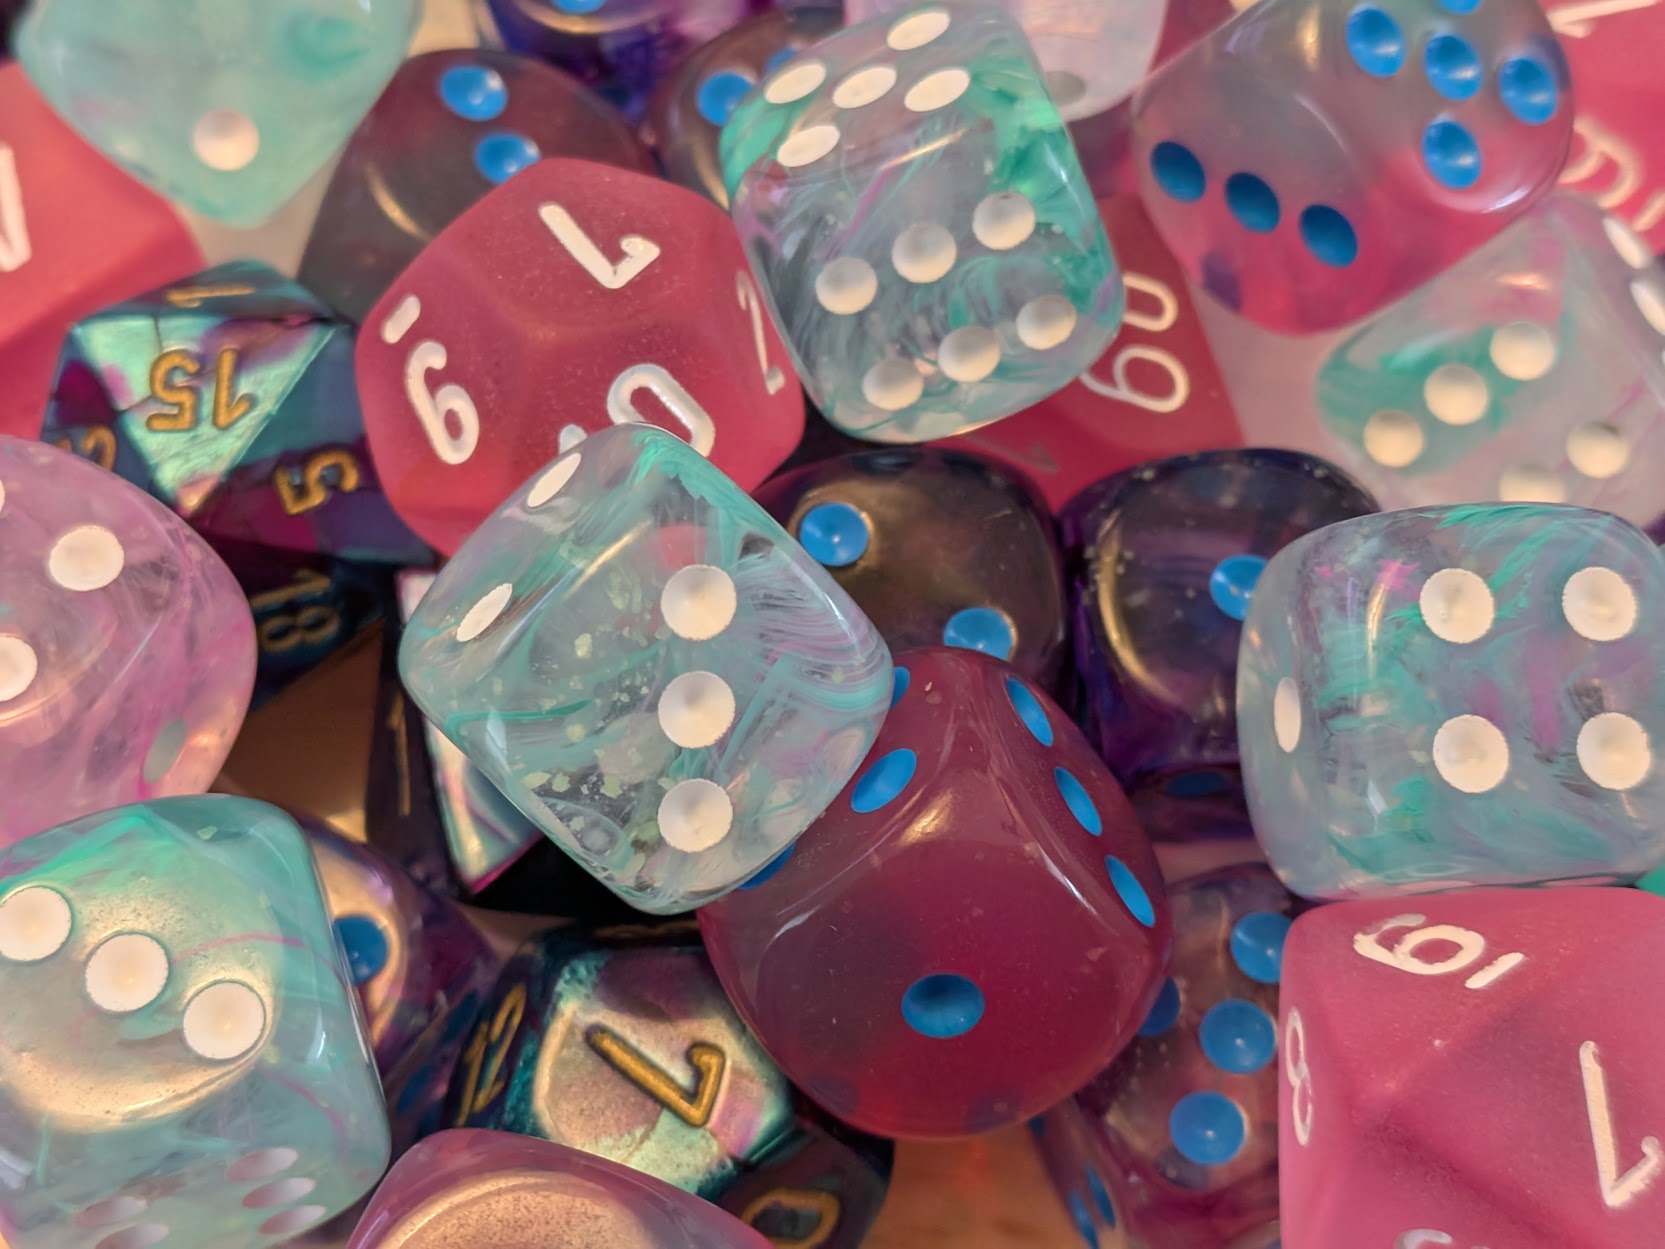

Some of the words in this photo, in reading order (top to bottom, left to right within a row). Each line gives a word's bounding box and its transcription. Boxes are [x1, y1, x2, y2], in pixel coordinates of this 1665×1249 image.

[145, 346, 256, 431] 15
[274, 449, 359, 516] 5
[1285, 1006, 1313, 1147] 8
